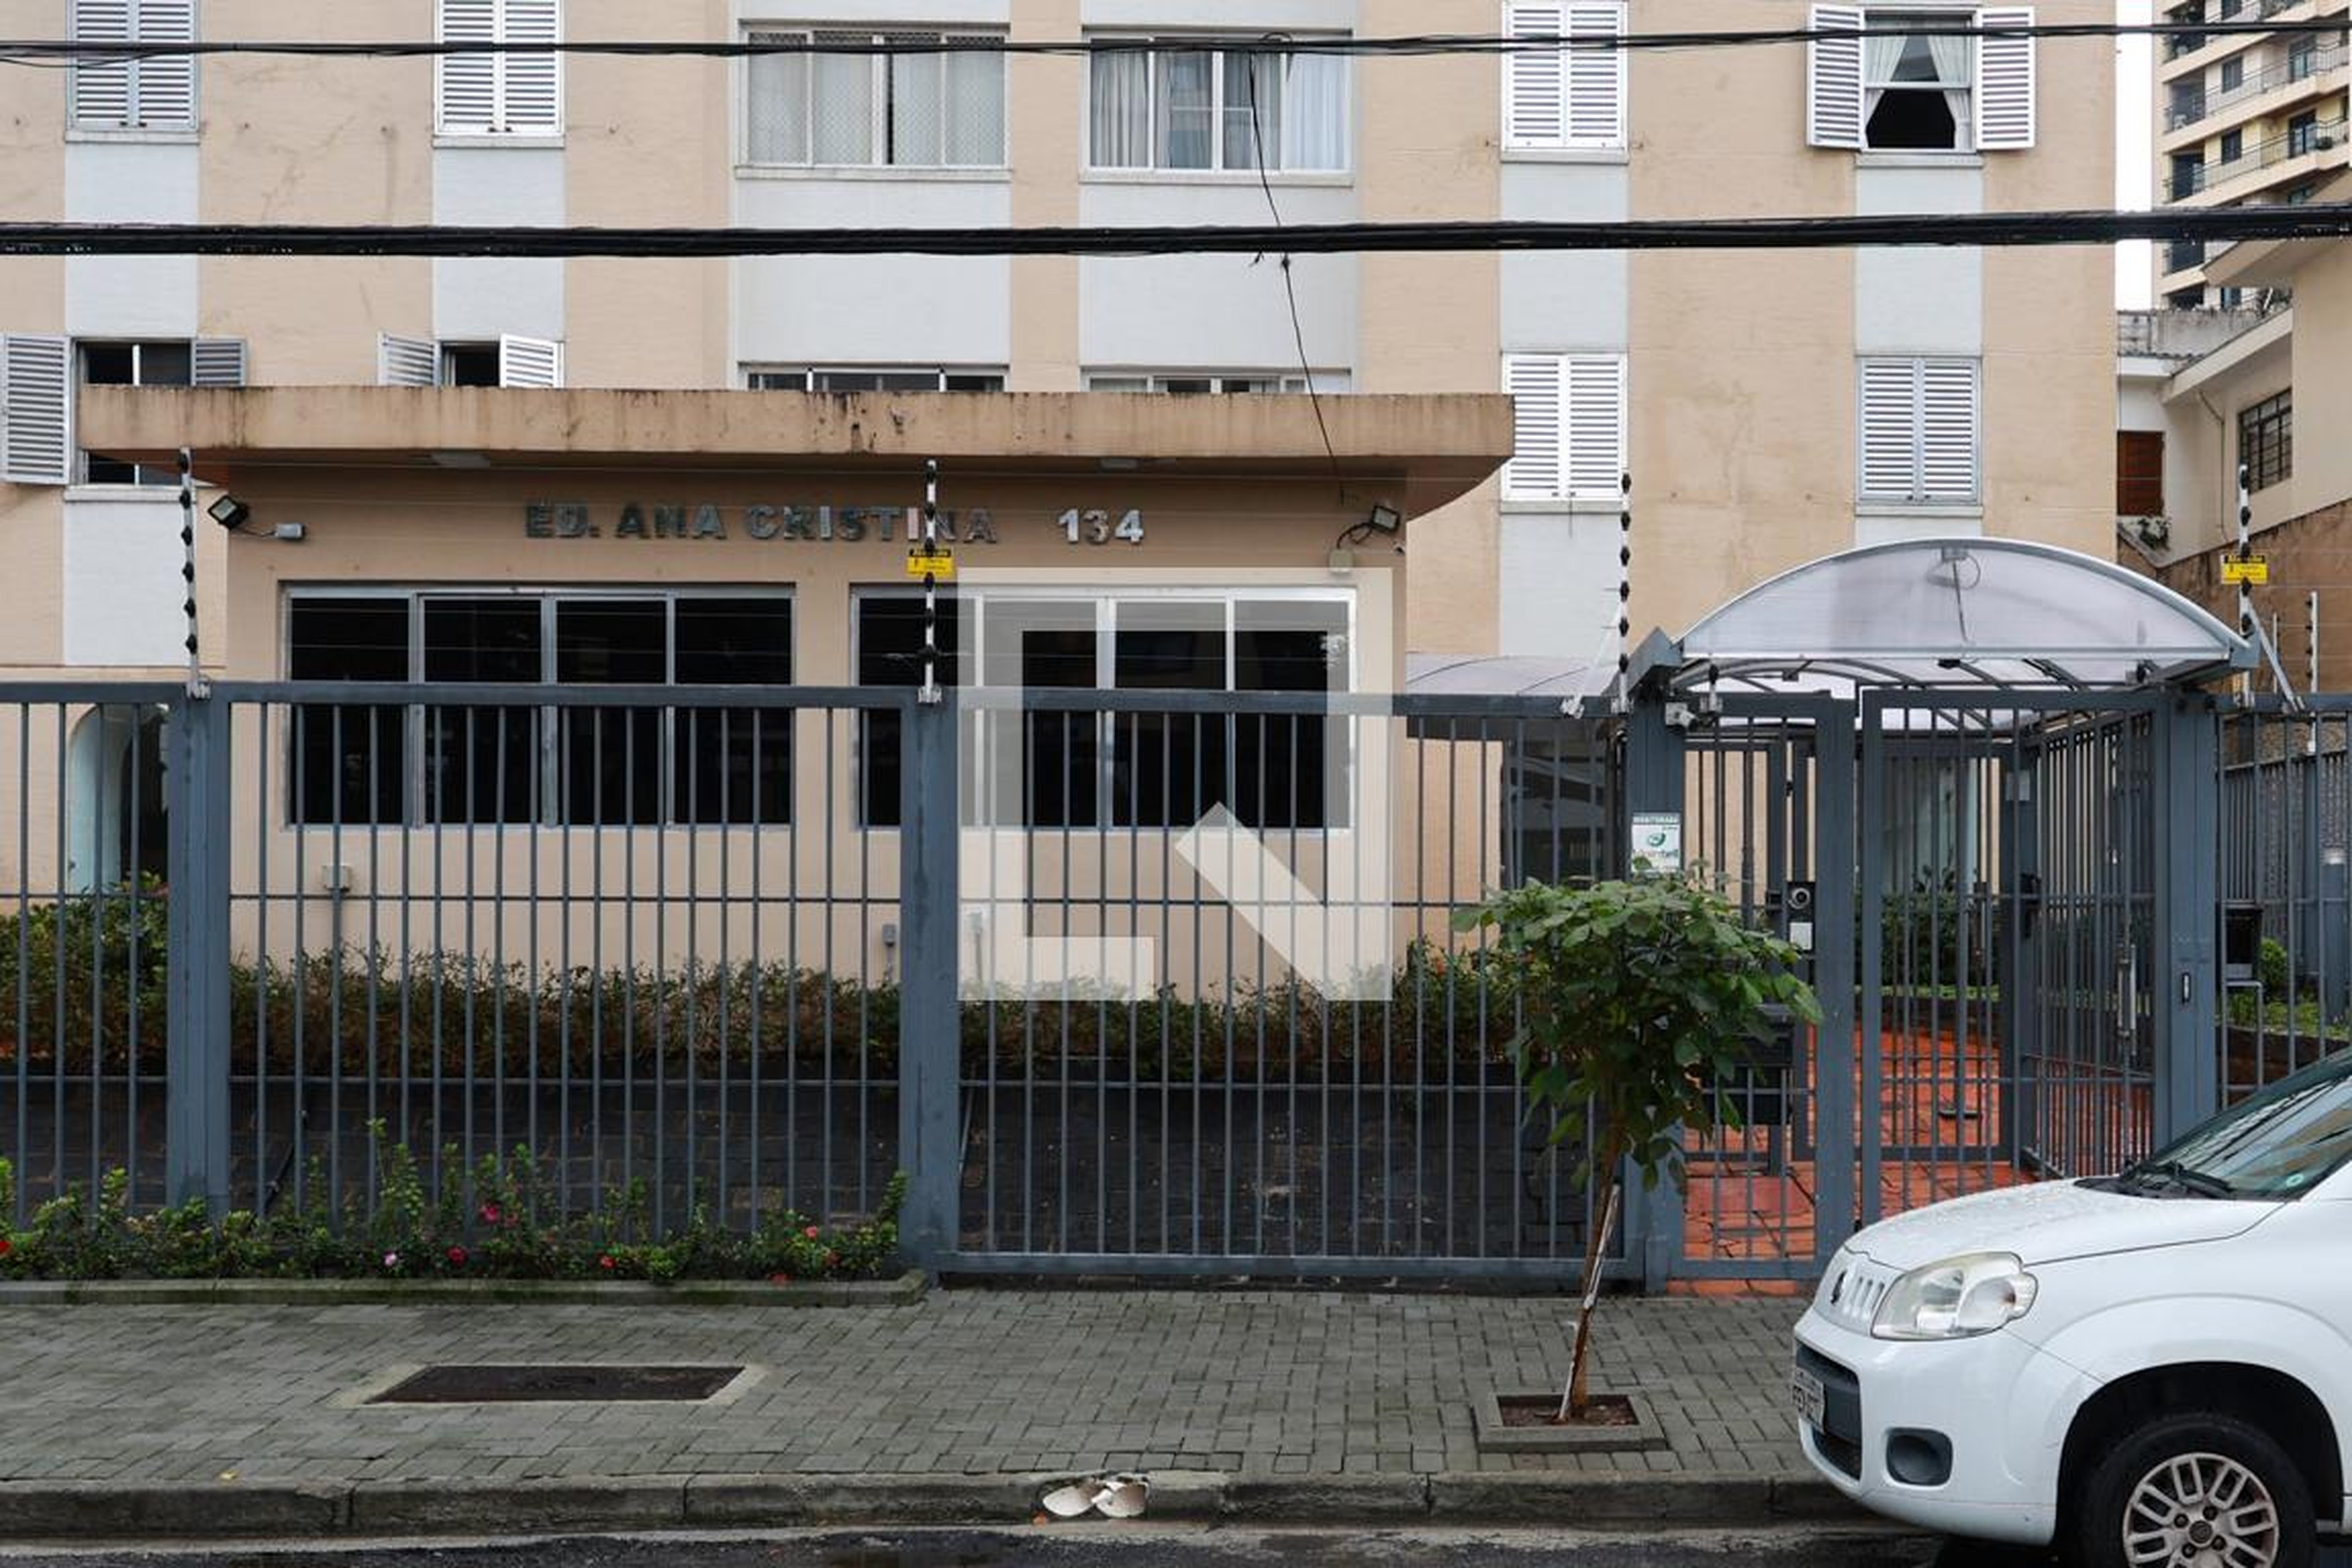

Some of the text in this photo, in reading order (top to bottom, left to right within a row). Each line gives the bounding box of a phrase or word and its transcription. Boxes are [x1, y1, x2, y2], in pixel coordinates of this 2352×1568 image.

[526, 505, 1144, 544] ED. ANA CRISTINA 134
